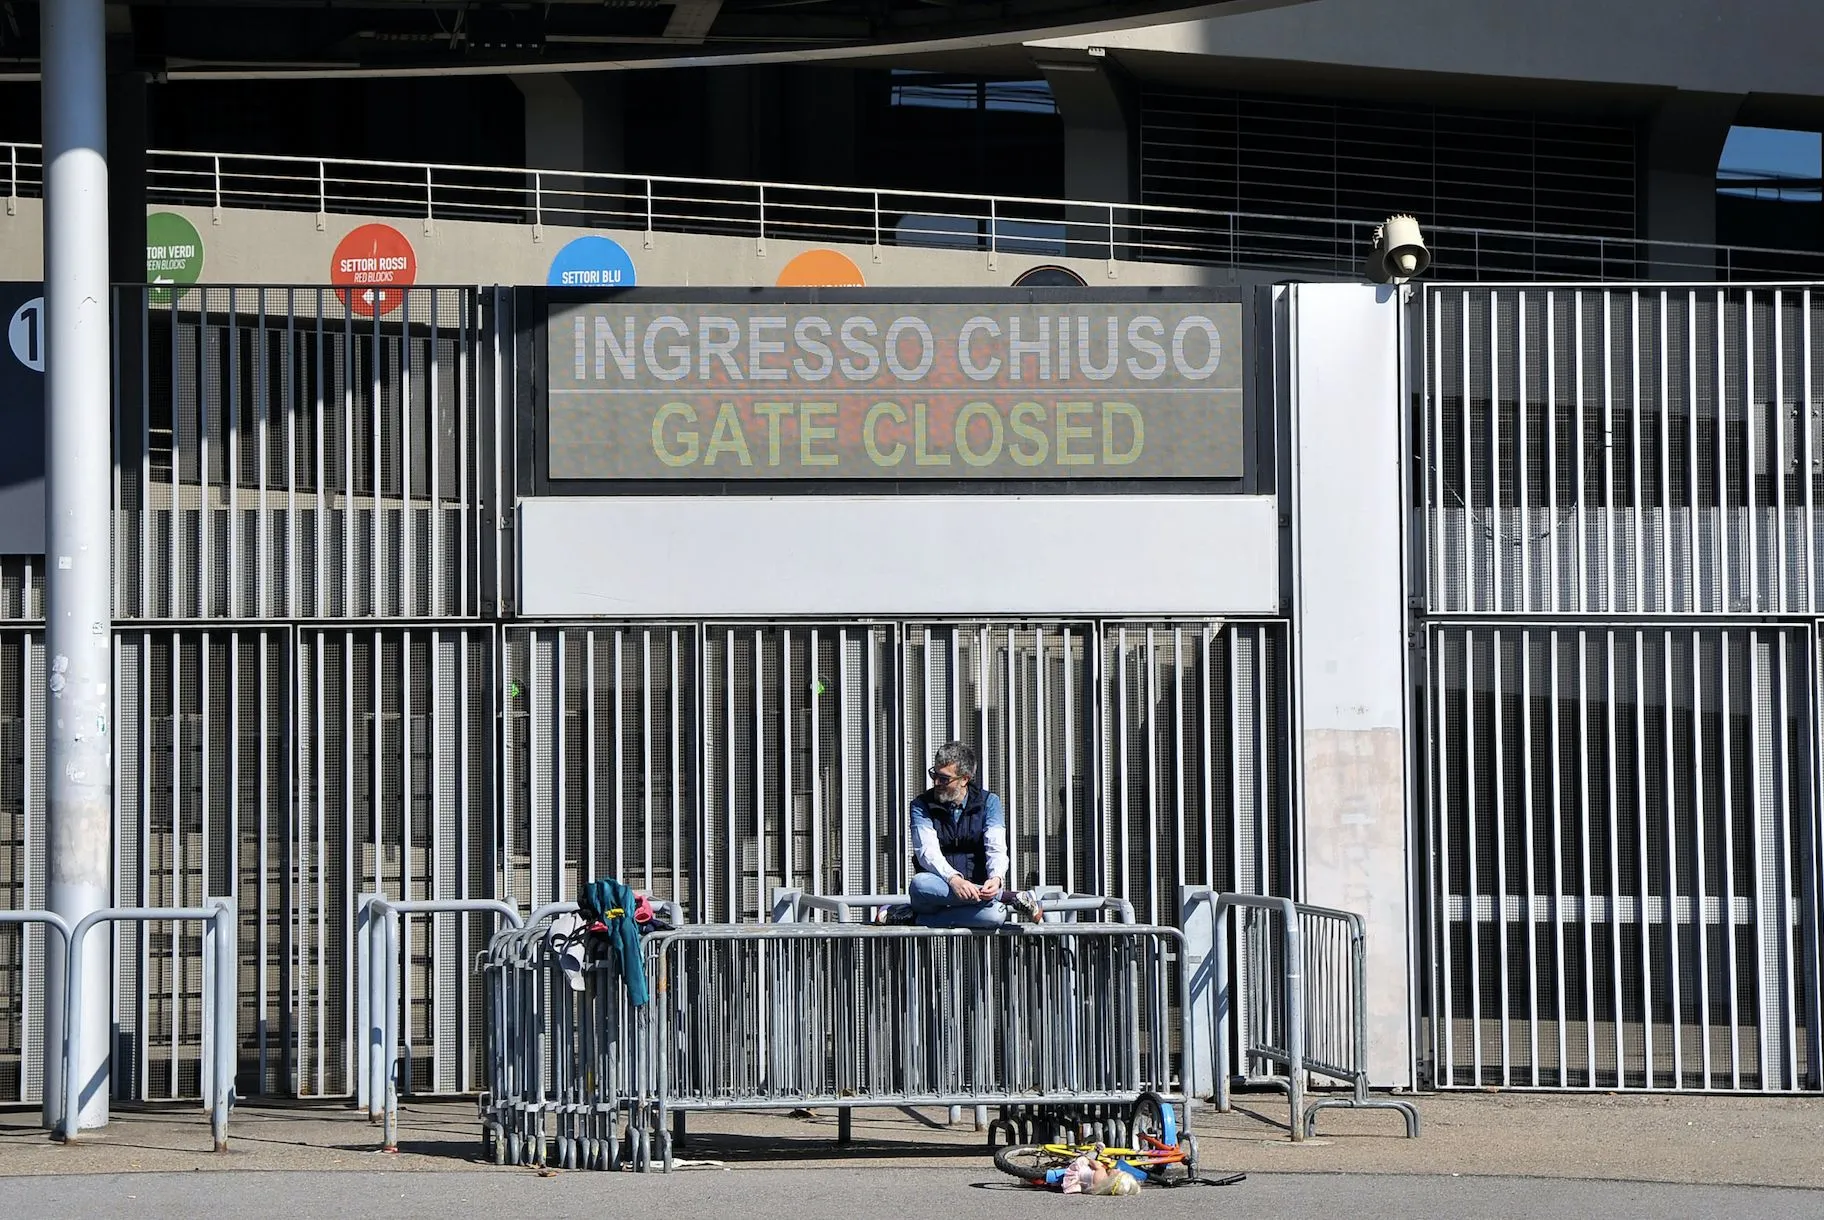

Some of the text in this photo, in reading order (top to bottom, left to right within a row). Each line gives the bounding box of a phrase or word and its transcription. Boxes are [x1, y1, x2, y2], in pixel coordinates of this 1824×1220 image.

[147, 245, 195, 259] TORI VERDI
[147, 259, 186, 271] EEN BLOCKS
[340, 257, 407, 272] SETTORI ROSSI
[354, 271, 394, 283] RED BLOCKS
[562, 270, 621, 283] SETTORI BLU
[574, 315, 1221, 381] INGRESSO CHIUSO
[651, 401, 1145, 468] GATE CLOSED
